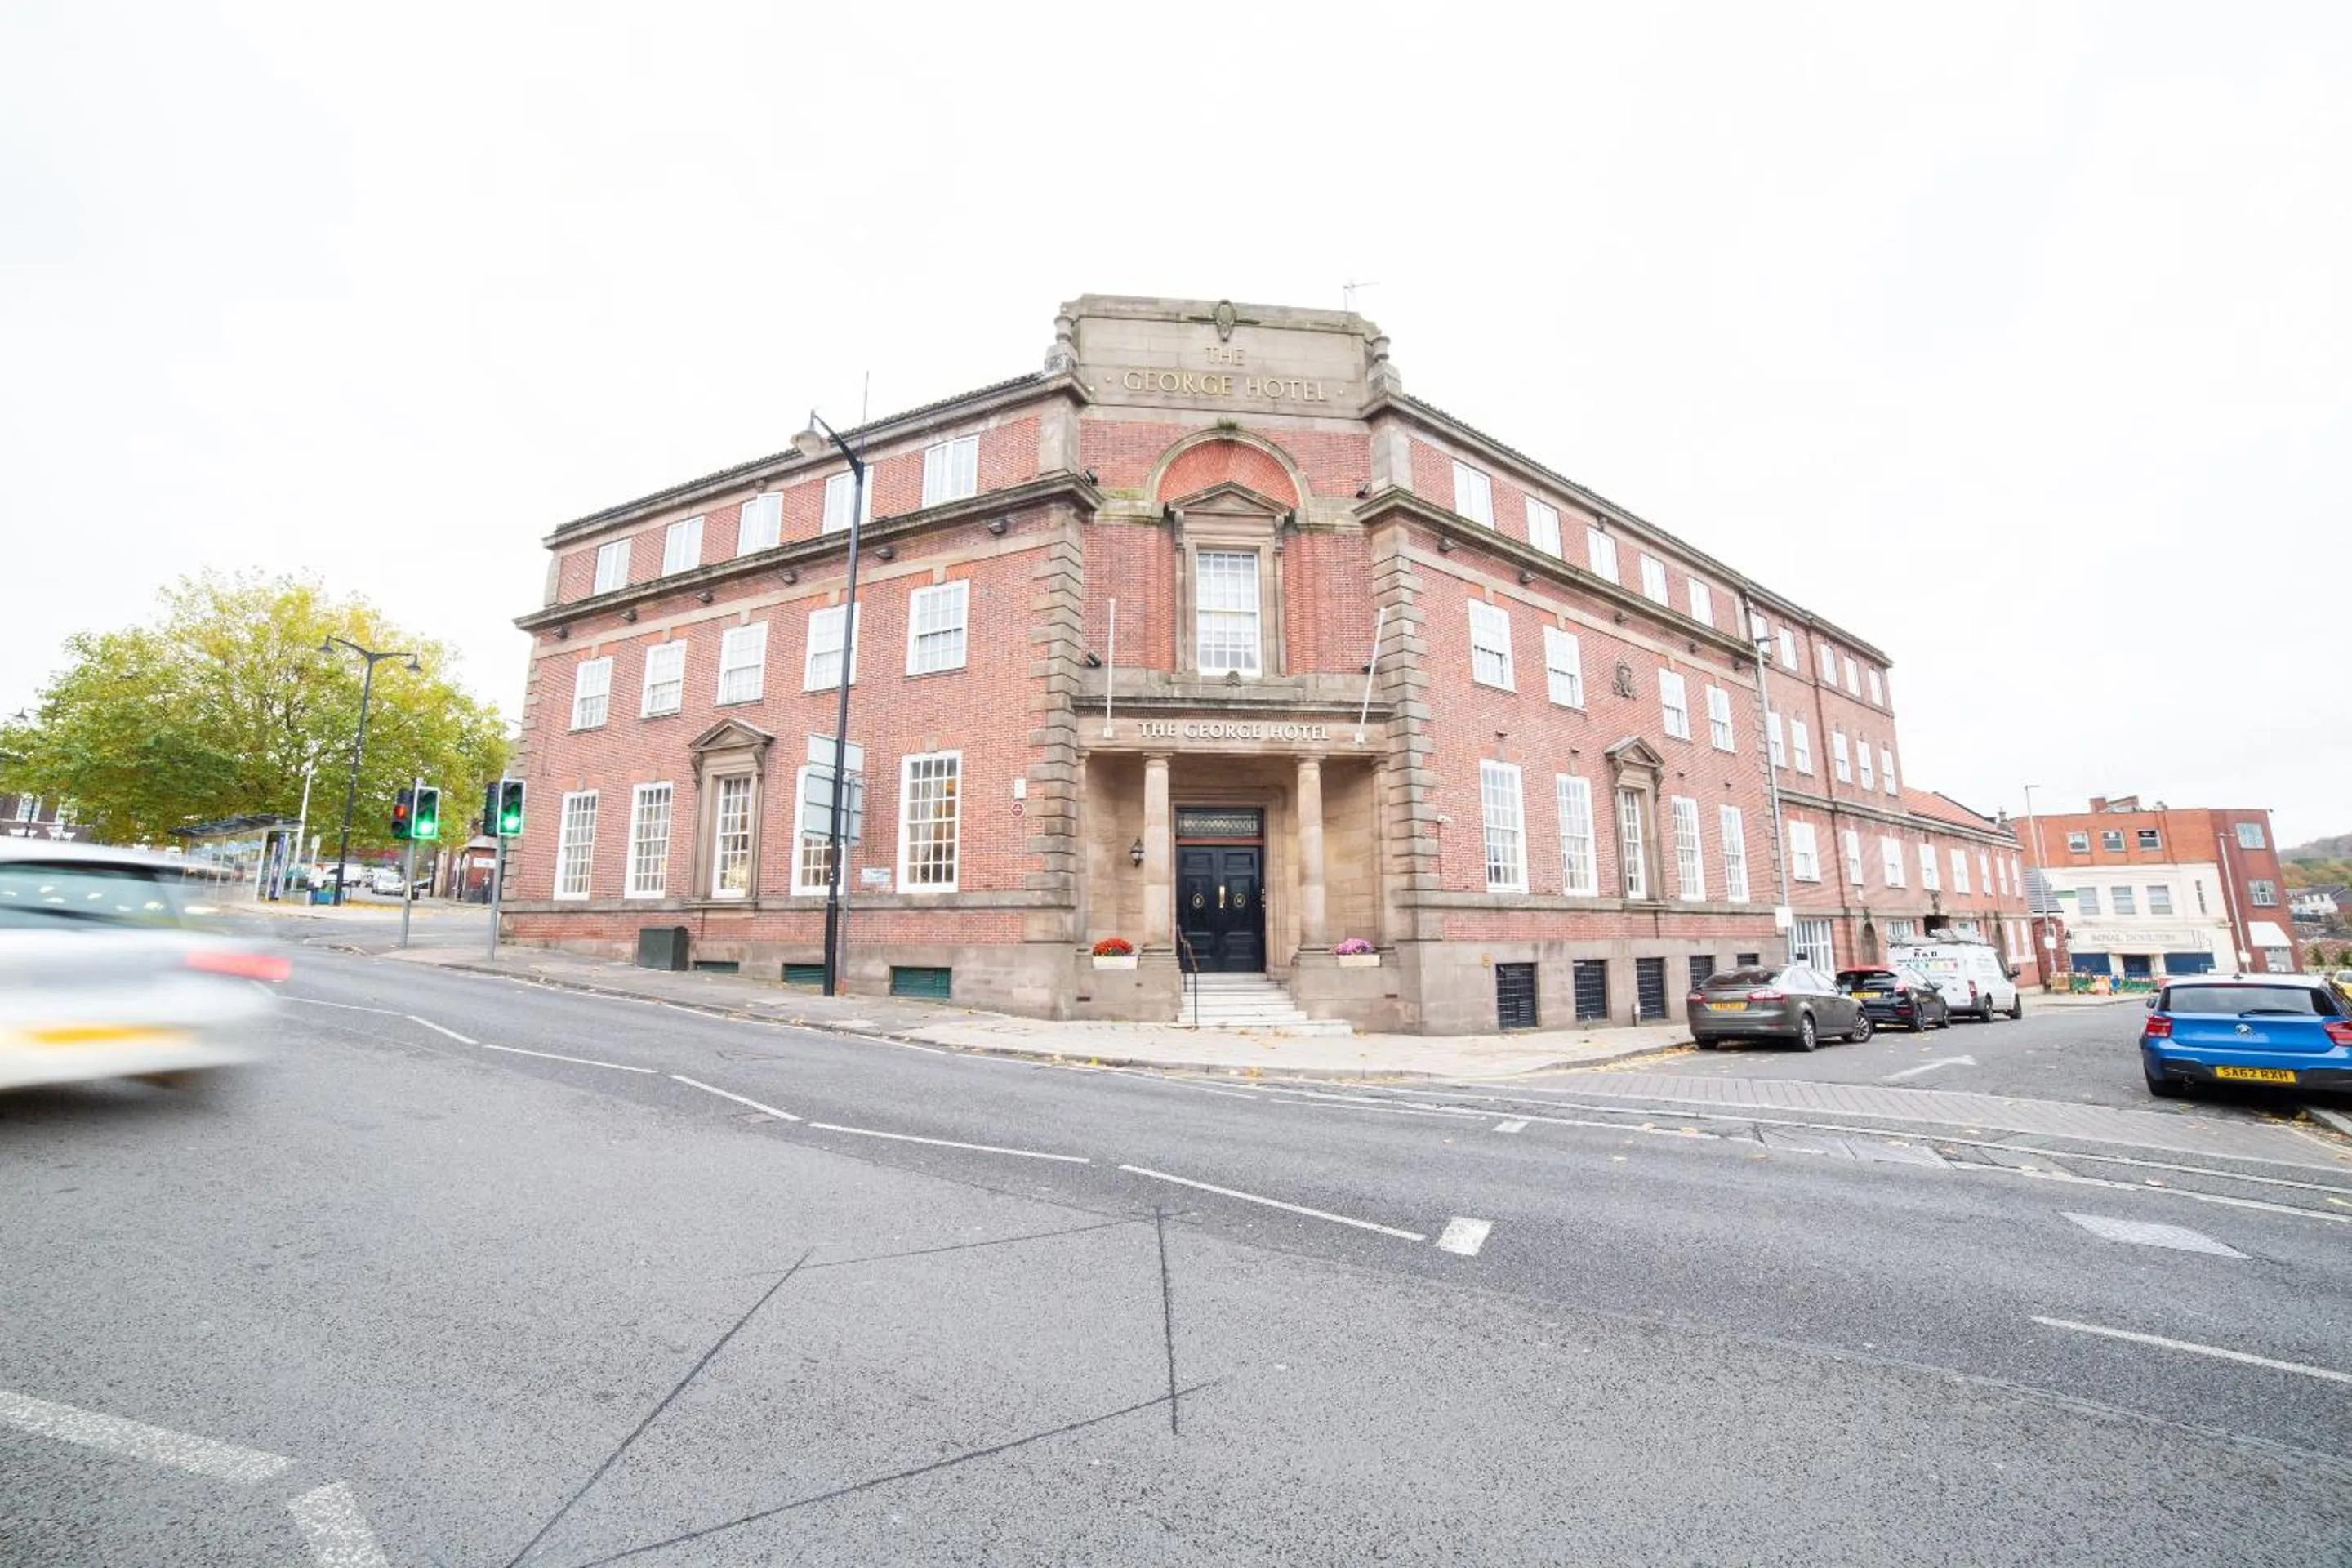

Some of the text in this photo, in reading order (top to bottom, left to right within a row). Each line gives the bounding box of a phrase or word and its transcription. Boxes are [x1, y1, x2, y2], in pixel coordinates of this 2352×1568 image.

[1205, 345, 1245, 366] THE
[1123, 371, 1330, 403] GEORGE HOTEL
[1138, 723, 1330, 742] THE GEORGE HOTEL
[2222, 1067, 2257, 1078] SA62
